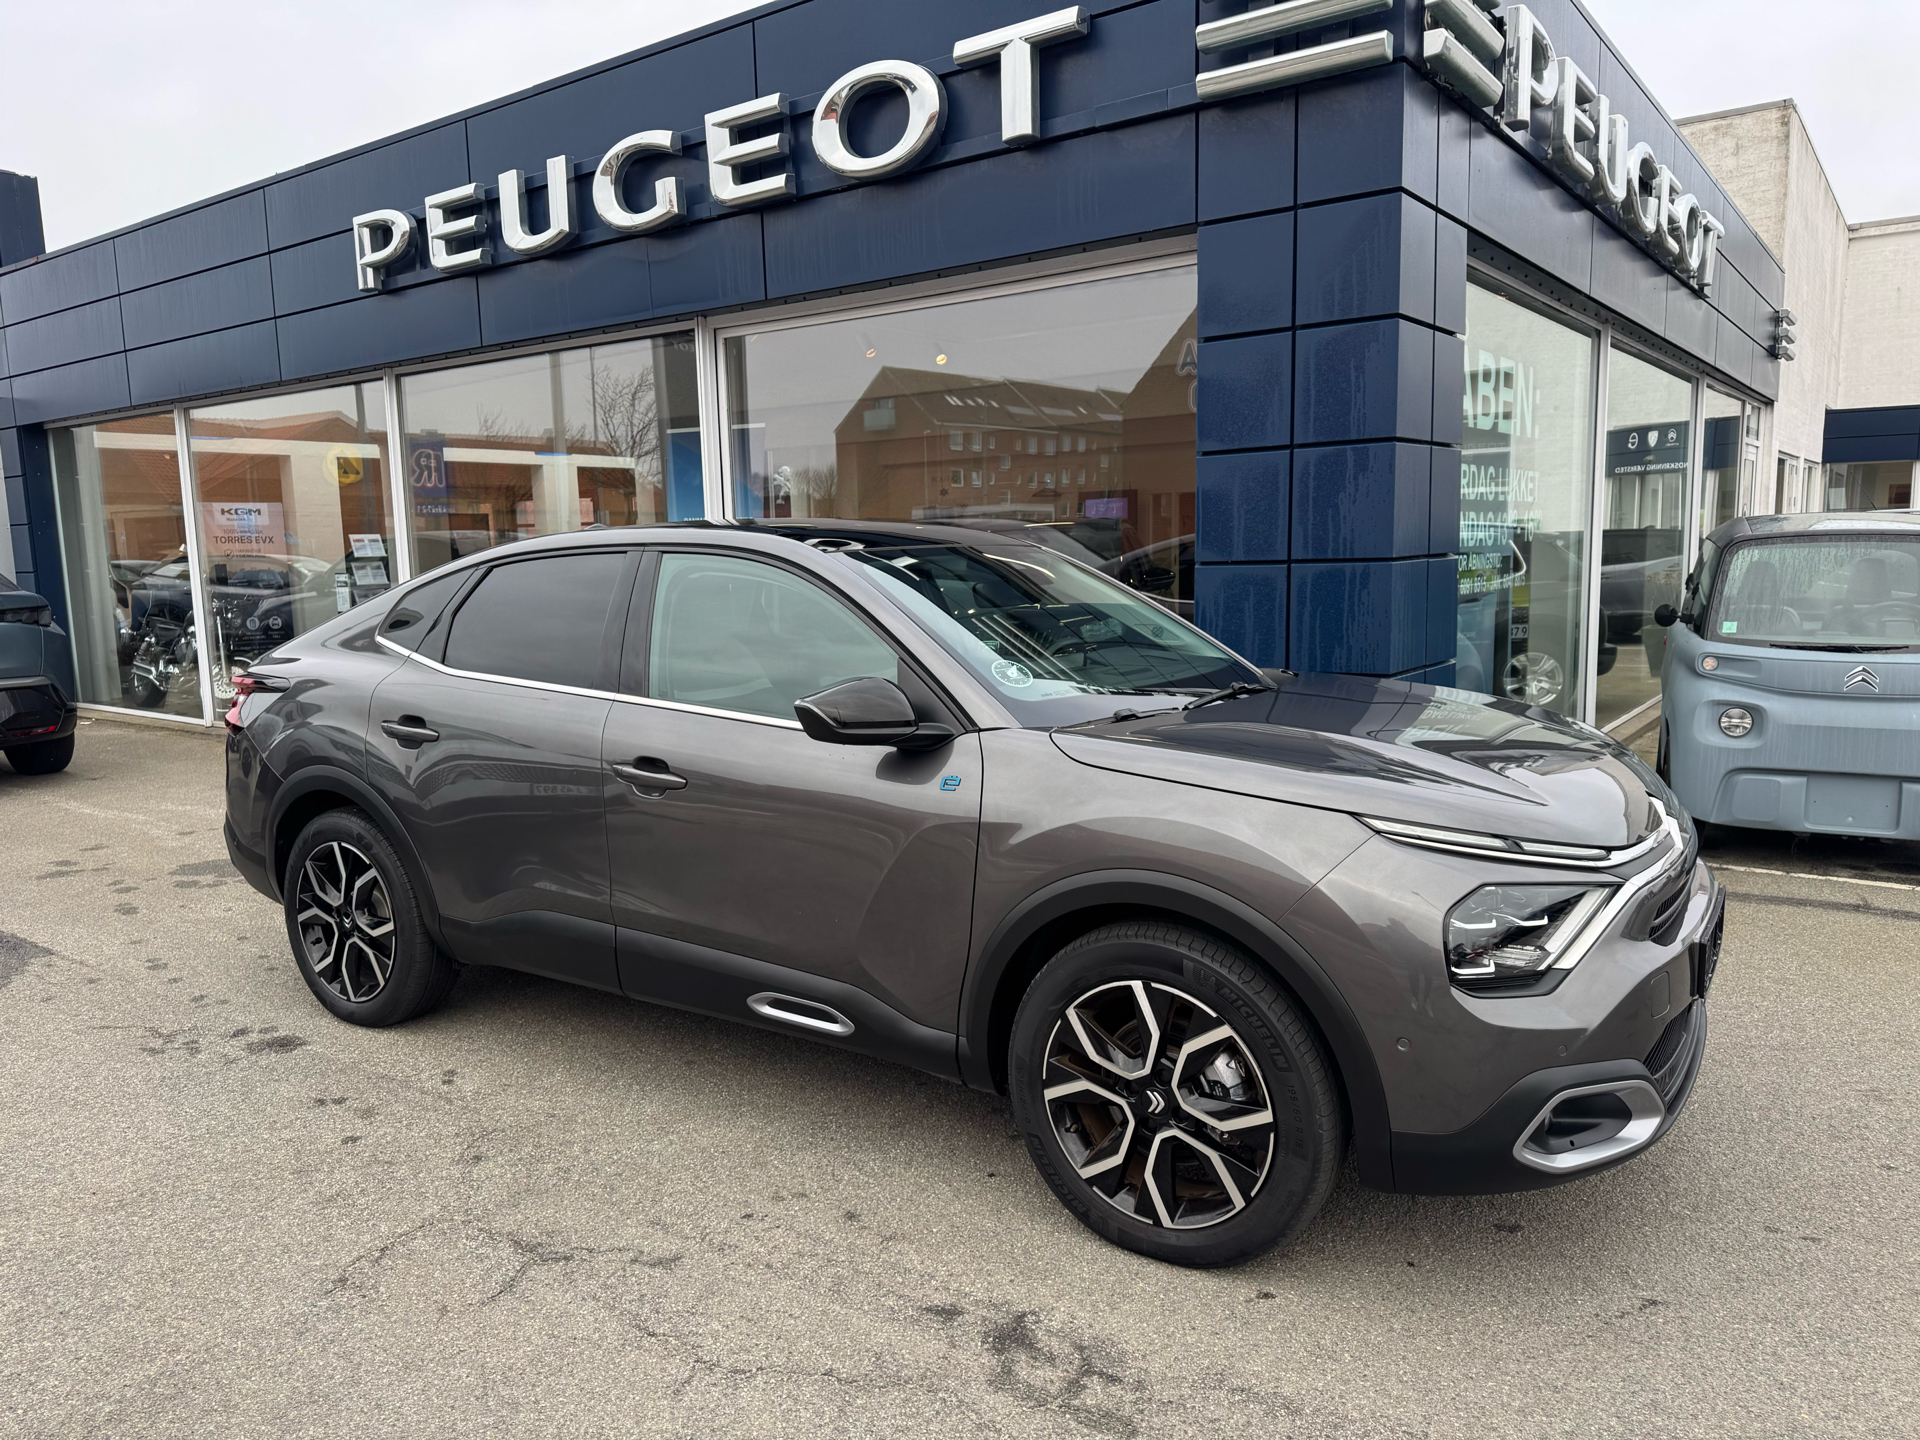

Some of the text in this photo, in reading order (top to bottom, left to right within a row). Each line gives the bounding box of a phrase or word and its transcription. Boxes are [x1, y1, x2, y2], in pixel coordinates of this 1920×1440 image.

[353, 5, 1090, 294] PEUGEOT
[1505, 4, 1725, 288] PEUGEOT
[220, 508, 262, 516] KGM
[1498, 467, 1540, 502] LUKKET
[213, 535, 274, 544] TORRES EVX
[1218, 984, 1290, 1069] MICHELIN
[1286, 1084, 1302, 1123] 195/60
[1030, 1136, 1087, 1214] MICHELIN
